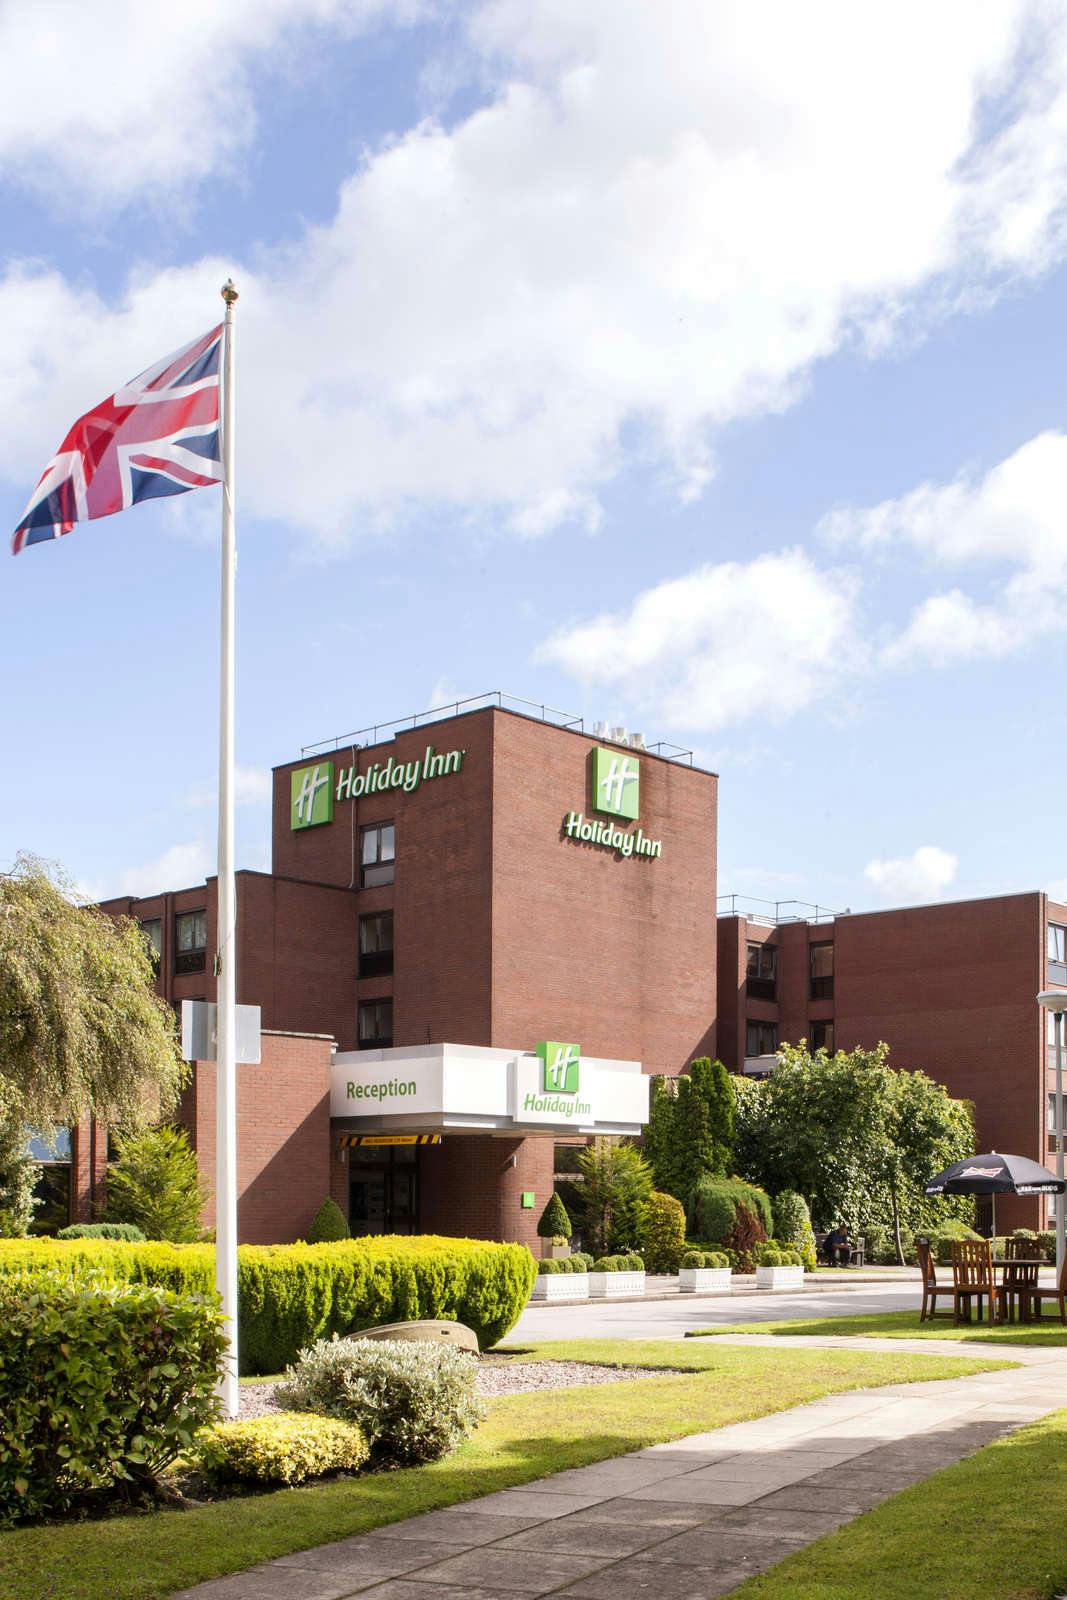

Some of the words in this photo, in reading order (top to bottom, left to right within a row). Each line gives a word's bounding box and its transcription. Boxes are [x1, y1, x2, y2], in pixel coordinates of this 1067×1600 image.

[336, 757, 420, 800] Holiday
[423, 745, 462, 779] Inn
[565, 811, 635, 857] Holiday
[635, 828, 662, 858] Inn
[346, 1078, 417, 1102] Reception
[523, 1093, 575, 1118] Holiday
[575, 1097, 592, 1115] Inn
